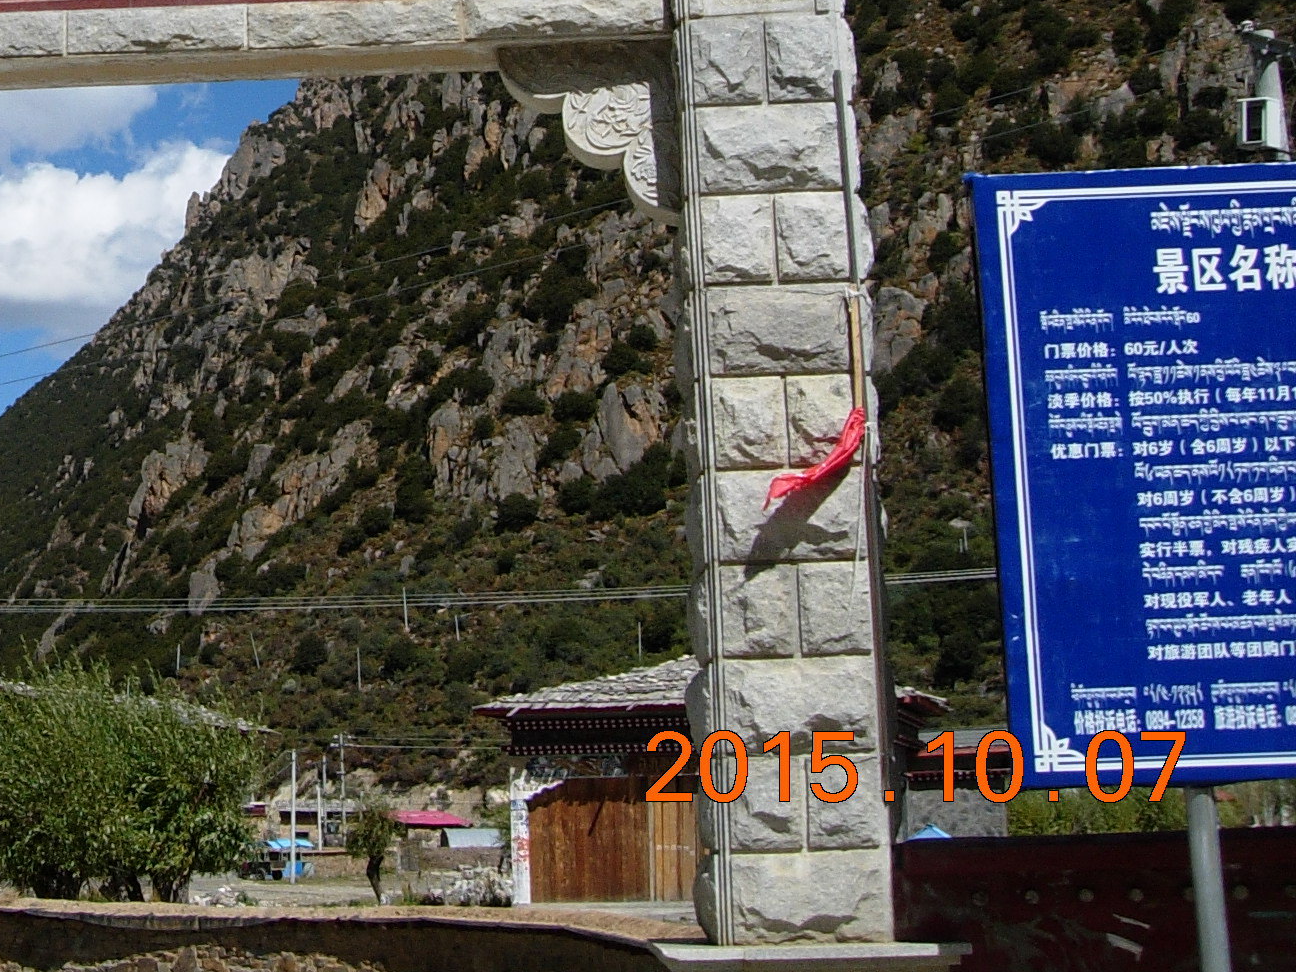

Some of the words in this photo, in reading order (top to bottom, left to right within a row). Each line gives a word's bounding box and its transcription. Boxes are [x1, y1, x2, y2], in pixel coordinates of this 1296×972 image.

[1153, 243, 1296, 294] 景区名称
[1124, 339, 1199, 356] 60元/人次
[1145, 709, 1204, 730] 0894-12358
